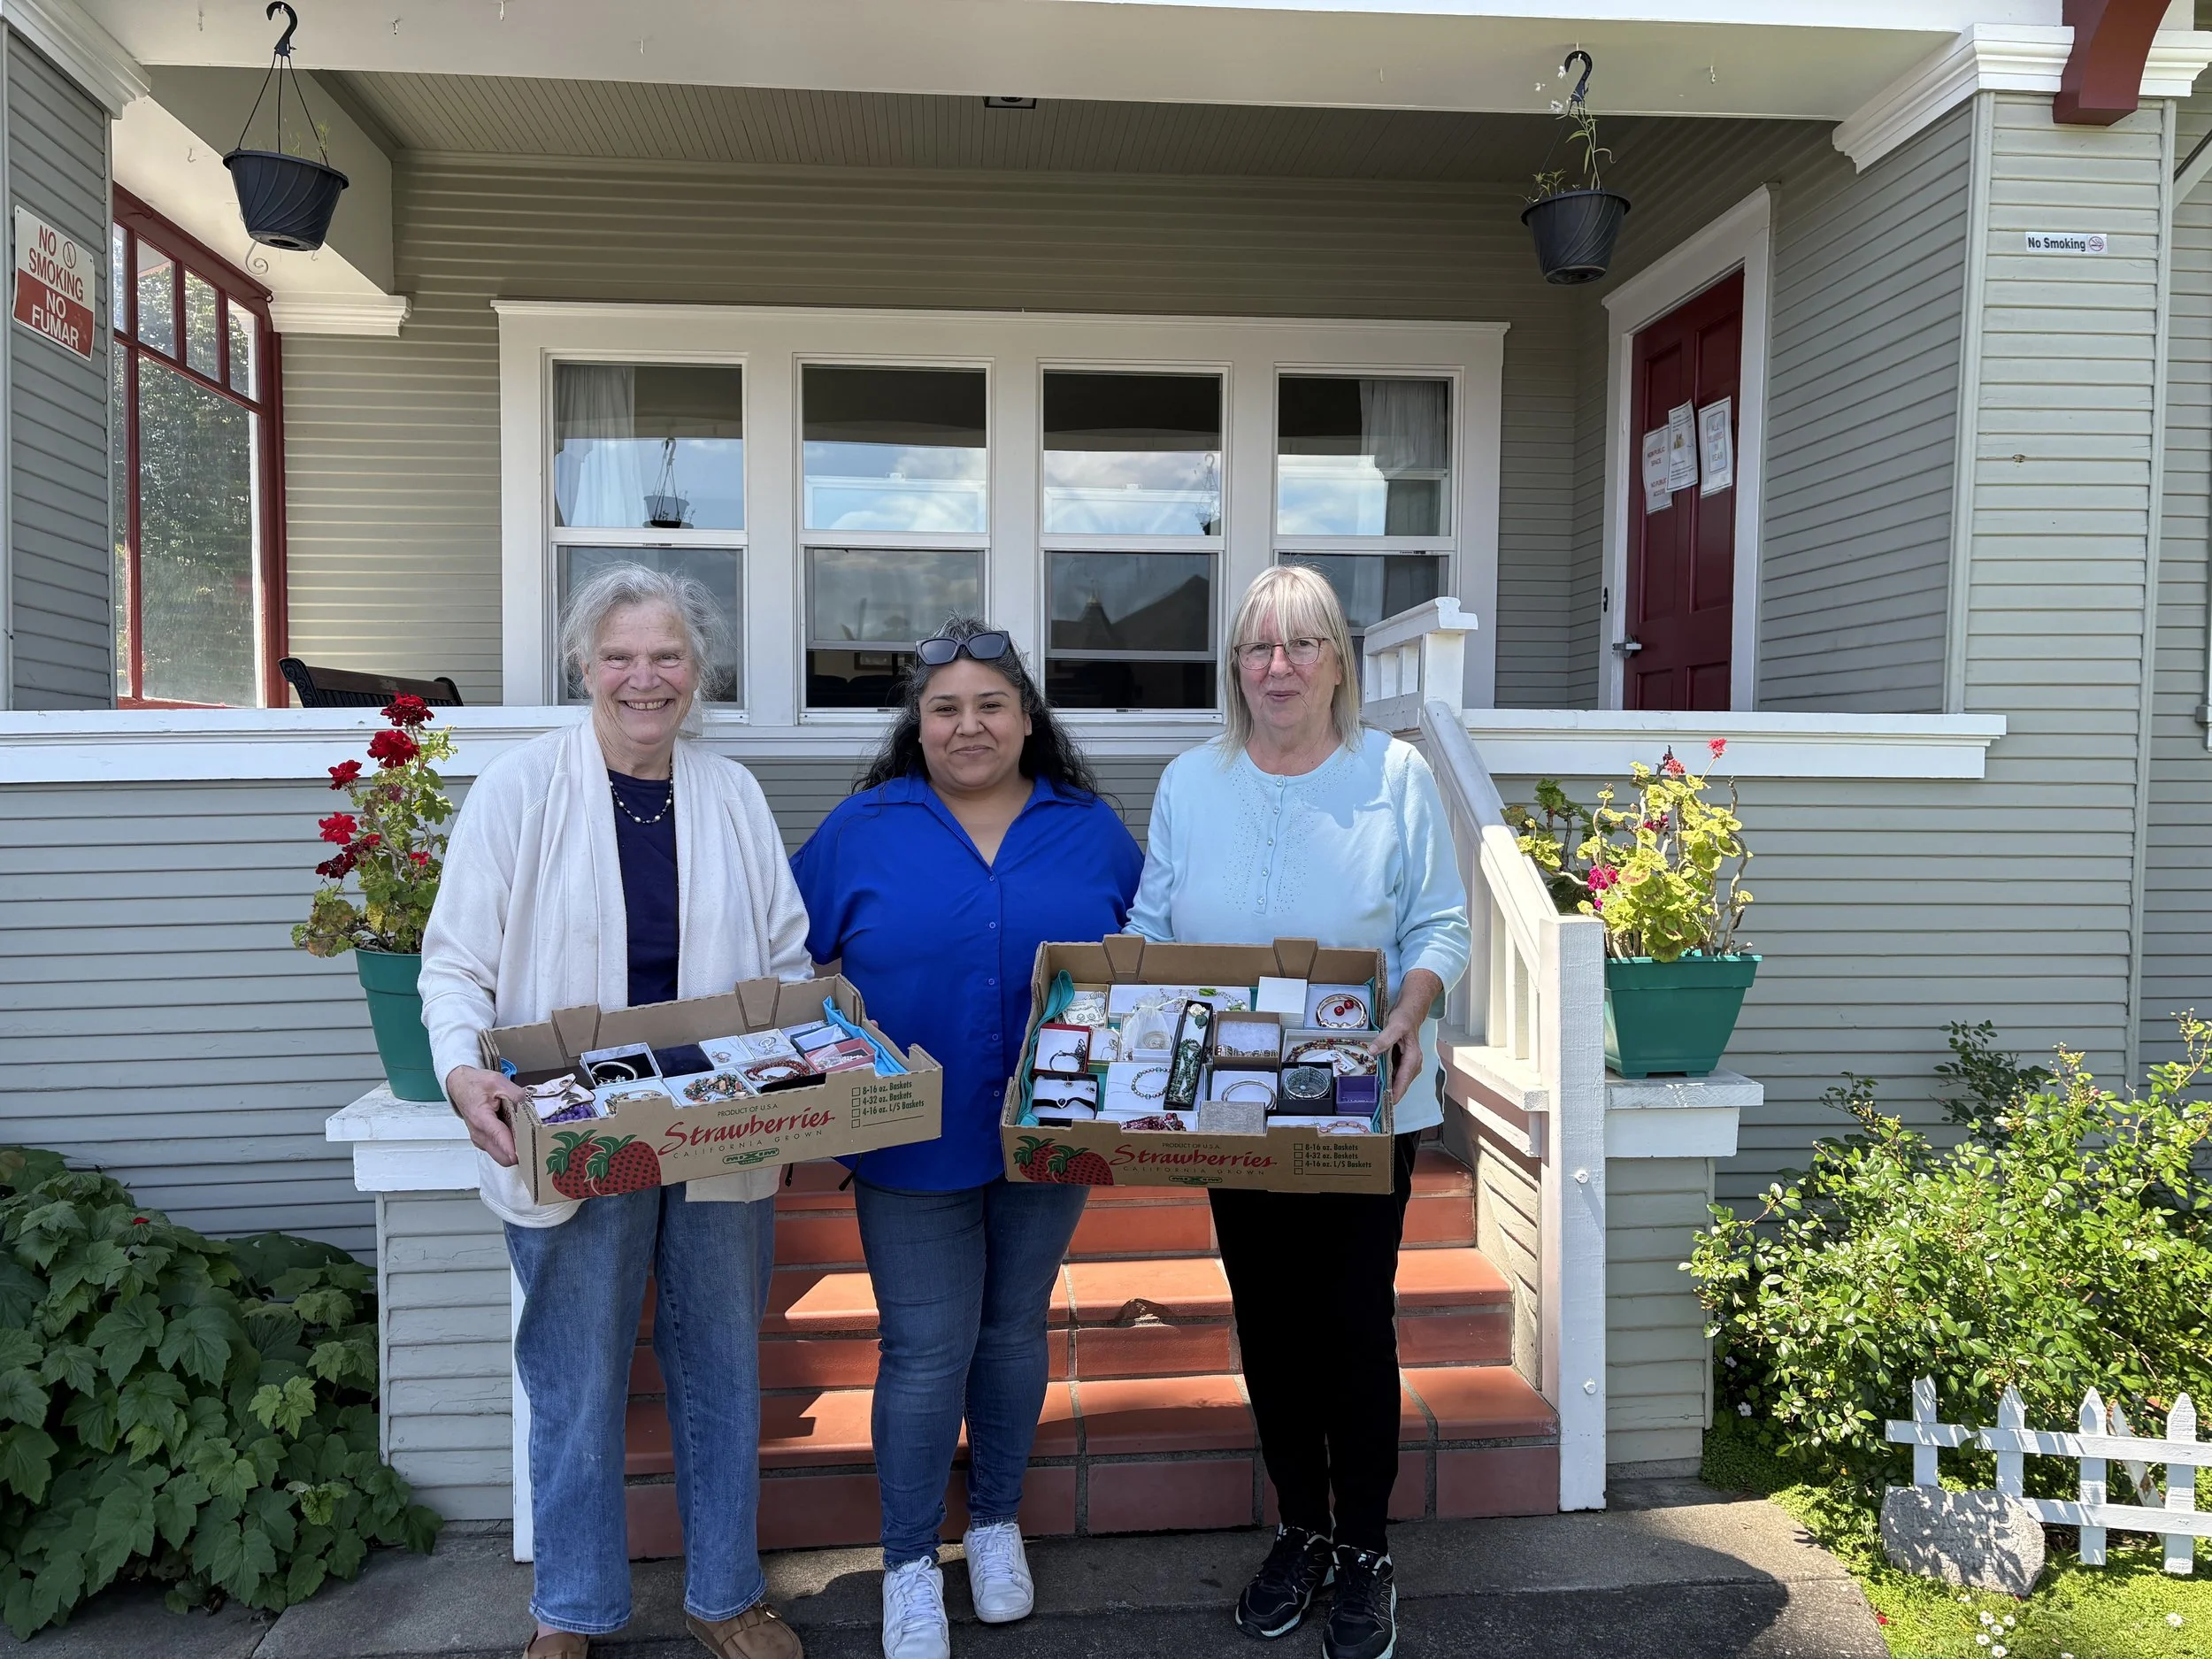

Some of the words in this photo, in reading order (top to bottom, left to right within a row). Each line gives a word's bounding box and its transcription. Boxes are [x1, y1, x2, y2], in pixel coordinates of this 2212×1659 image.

[39, 225, 57, 257] NO
[2028, 237, 2041, 248] No
[2044, 237, 2086, 252] Smoking
[29, 247, 84, 303] SMOKING
[46, 288, 66, 319] NO
[32, 303, 80, 349] FUMAR
[862, 1085, 878, 1095] 8-16
[889, 1080, 912, 1091] Baskets
[862, 1095, 878, 1106] 4-32
[889, 1091, 912, 1102] Baskets
[718, 1107, 748, 1118] PRODUCT
[862, 1106, 878, 1116] 4-16
[889, 1102, 901, 1113] L/S
[902, 1100, 925, 1110] Baskets
[657, 1107, 836, 1156] Strawberries
[673, 1140, 763, 1159] CALIFORNIA
[774, 1130, 823, 1143] GROWN
[1109, 1144, 1278, 1168] Strawberries
